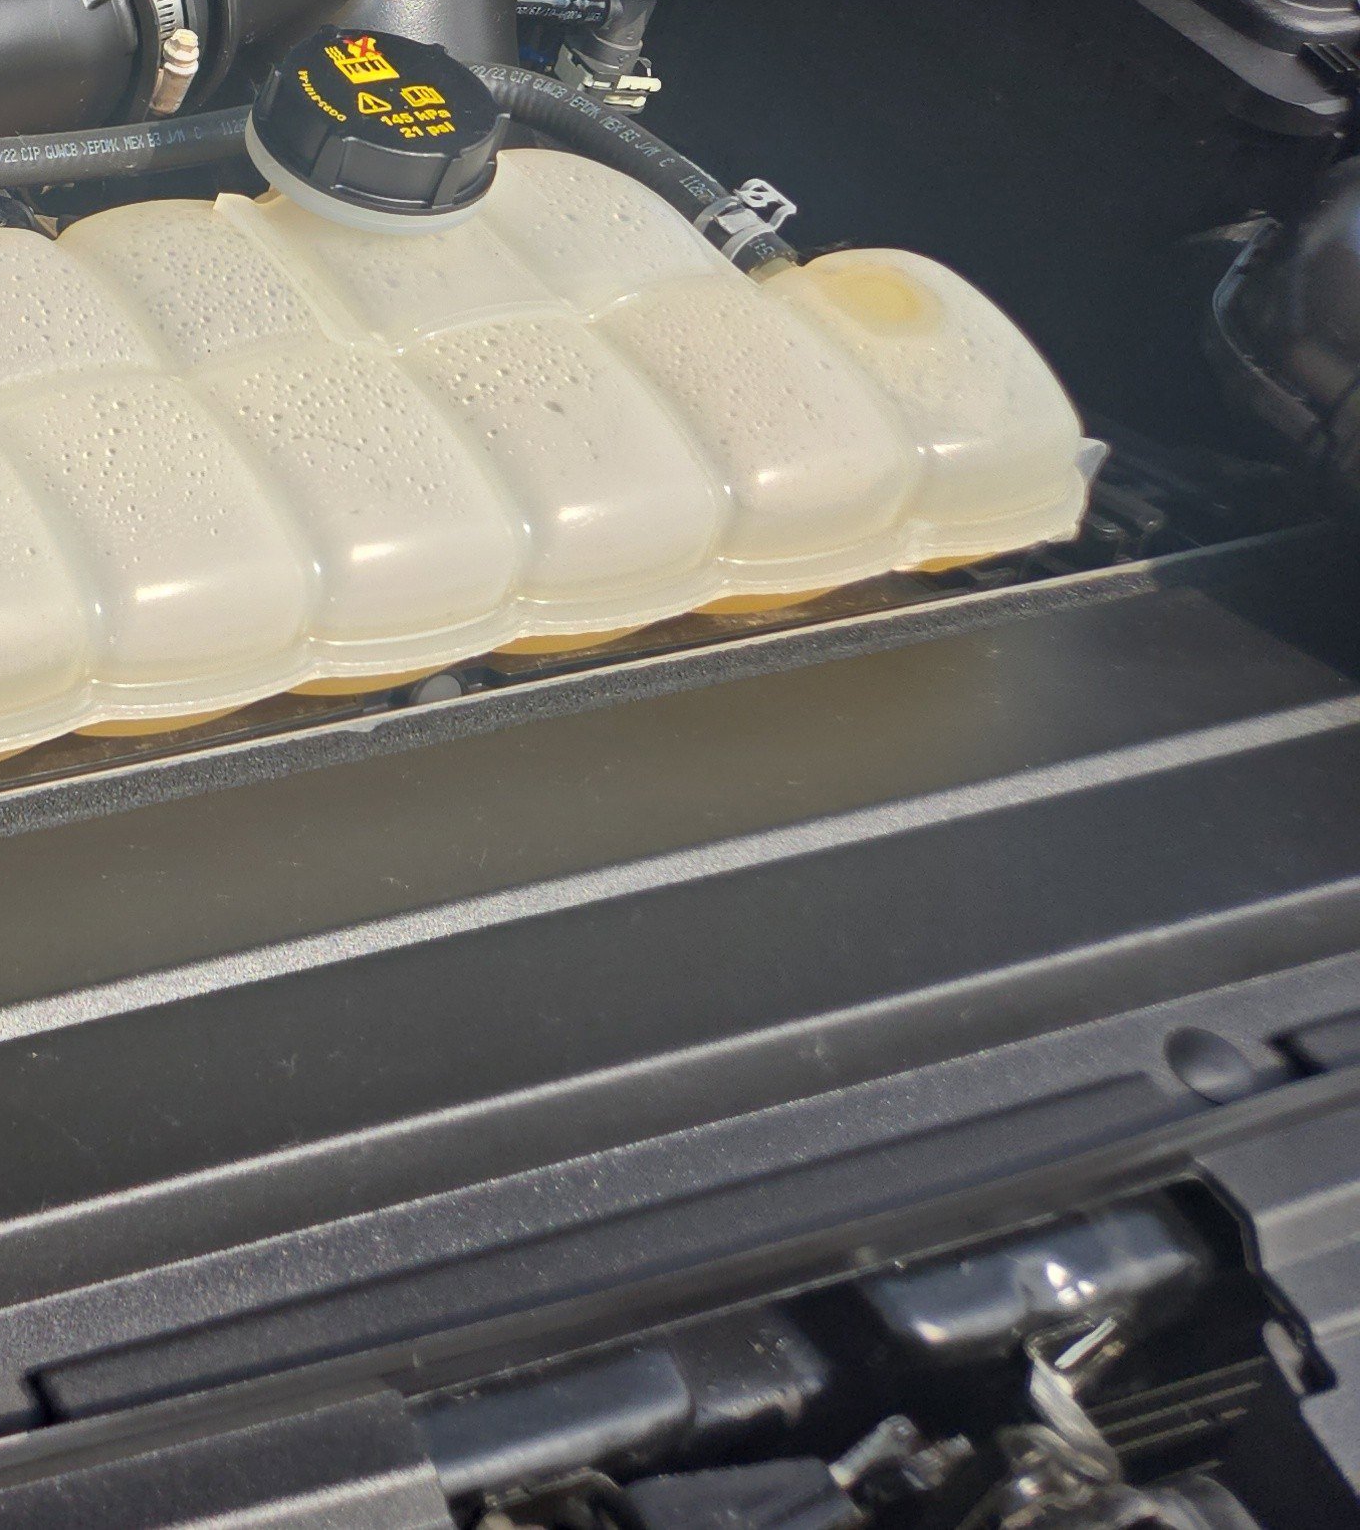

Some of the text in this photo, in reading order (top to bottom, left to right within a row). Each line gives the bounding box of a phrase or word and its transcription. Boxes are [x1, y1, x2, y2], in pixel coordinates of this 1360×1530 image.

[510, 71, 528, 84] CIP
[381, 108, 451, 126] 145 kPa
[400, 121, 456, 139] 21 psi
[21, 146, 40, 162] CIP
[125, 135, 144, 152] MEX
[194, 127, 202, 141] C
